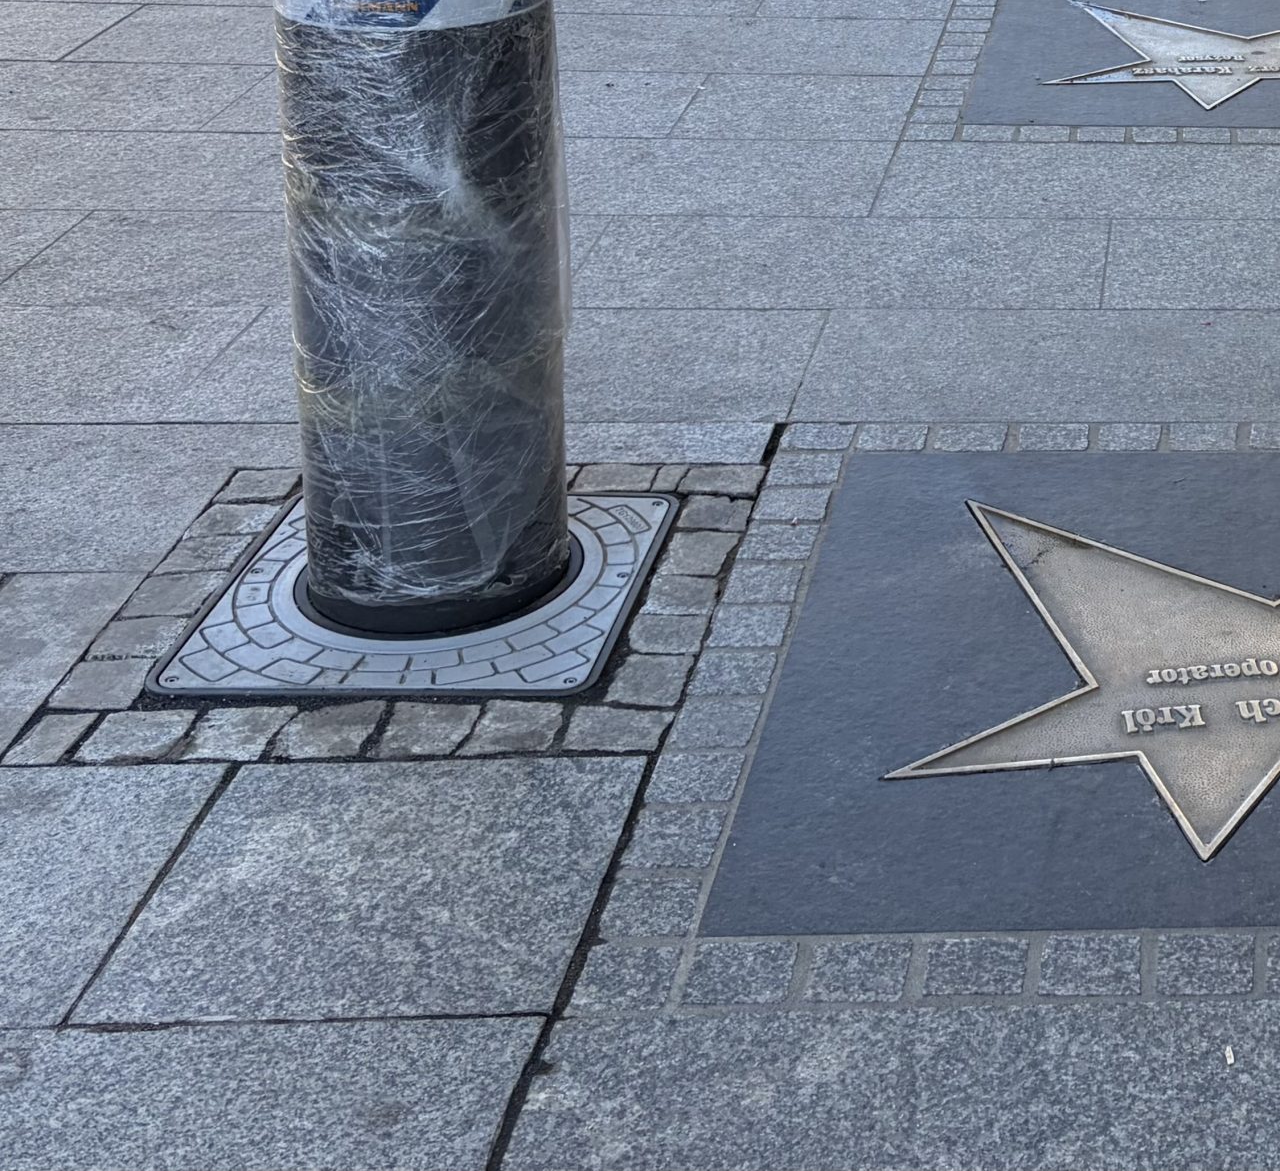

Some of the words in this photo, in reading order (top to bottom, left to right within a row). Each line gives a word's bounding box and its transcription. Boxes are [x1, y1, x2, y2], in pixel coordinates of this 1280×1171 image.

[1131, 65, 1233, 77] Karabasz
[1146, 657, 1280, 686] operator
[1121, 703, 1206, 733] Król
